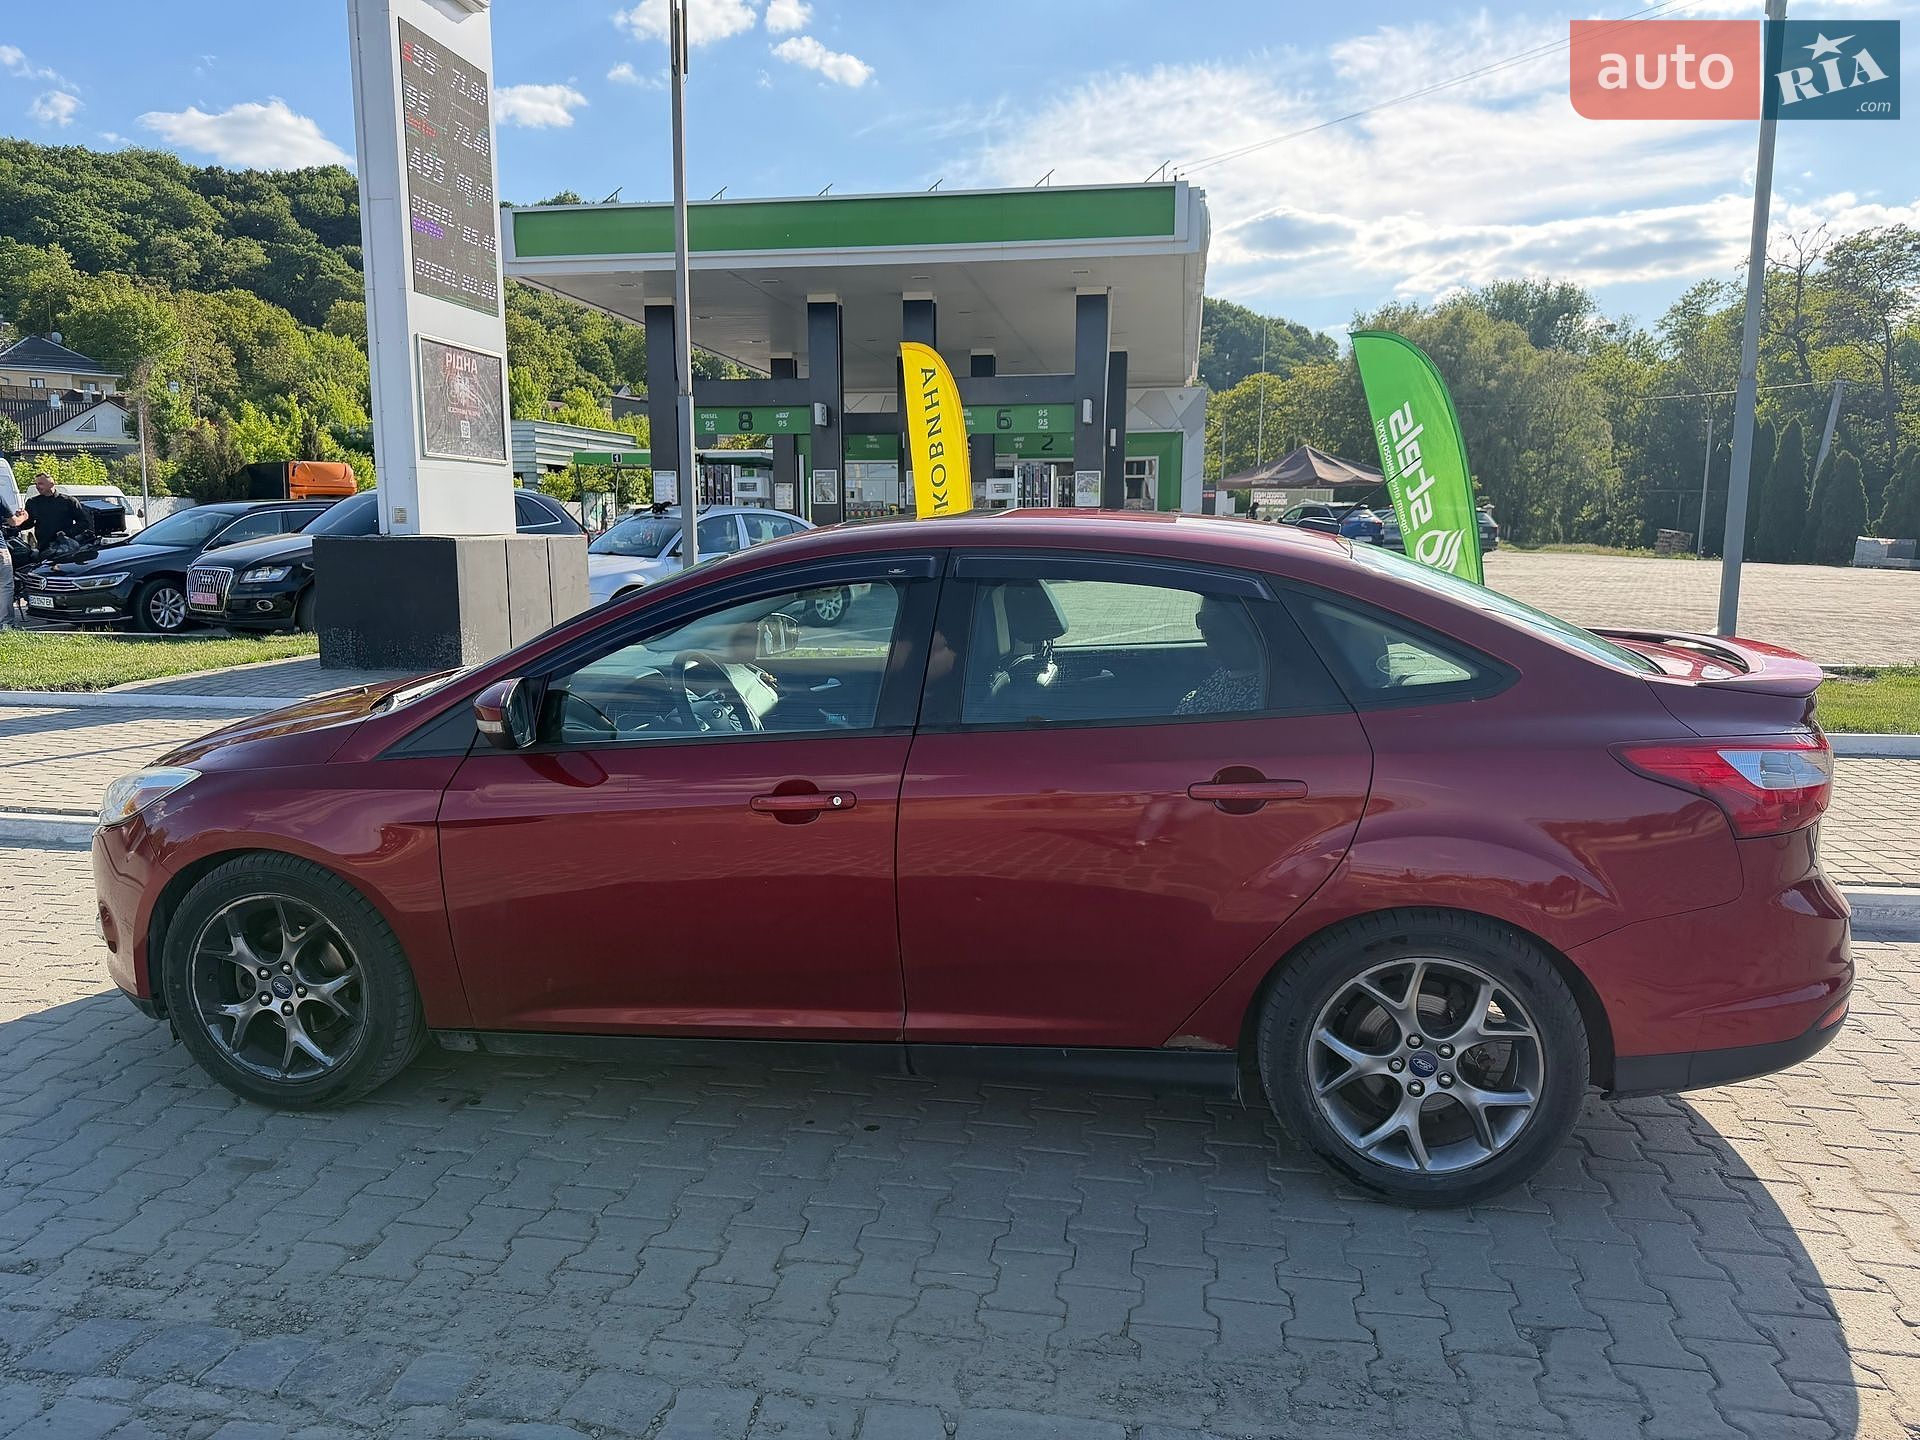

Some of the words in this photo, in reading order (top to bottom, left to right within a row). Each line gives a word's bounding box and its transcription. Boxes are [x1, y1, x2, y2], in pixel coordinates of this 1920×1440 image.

[408, 146, 446, 184] A95
[996, 408, 1013, 430] 6
[1038, 409, 1048, 417] 95
[705, 420, 715, 428] 95
[738, 411, 753, 431] 8
[777, 419, 788, 427] 95
[1038, 418, 1048, 426] 95
[1041, 434, 1054, 451] 2
